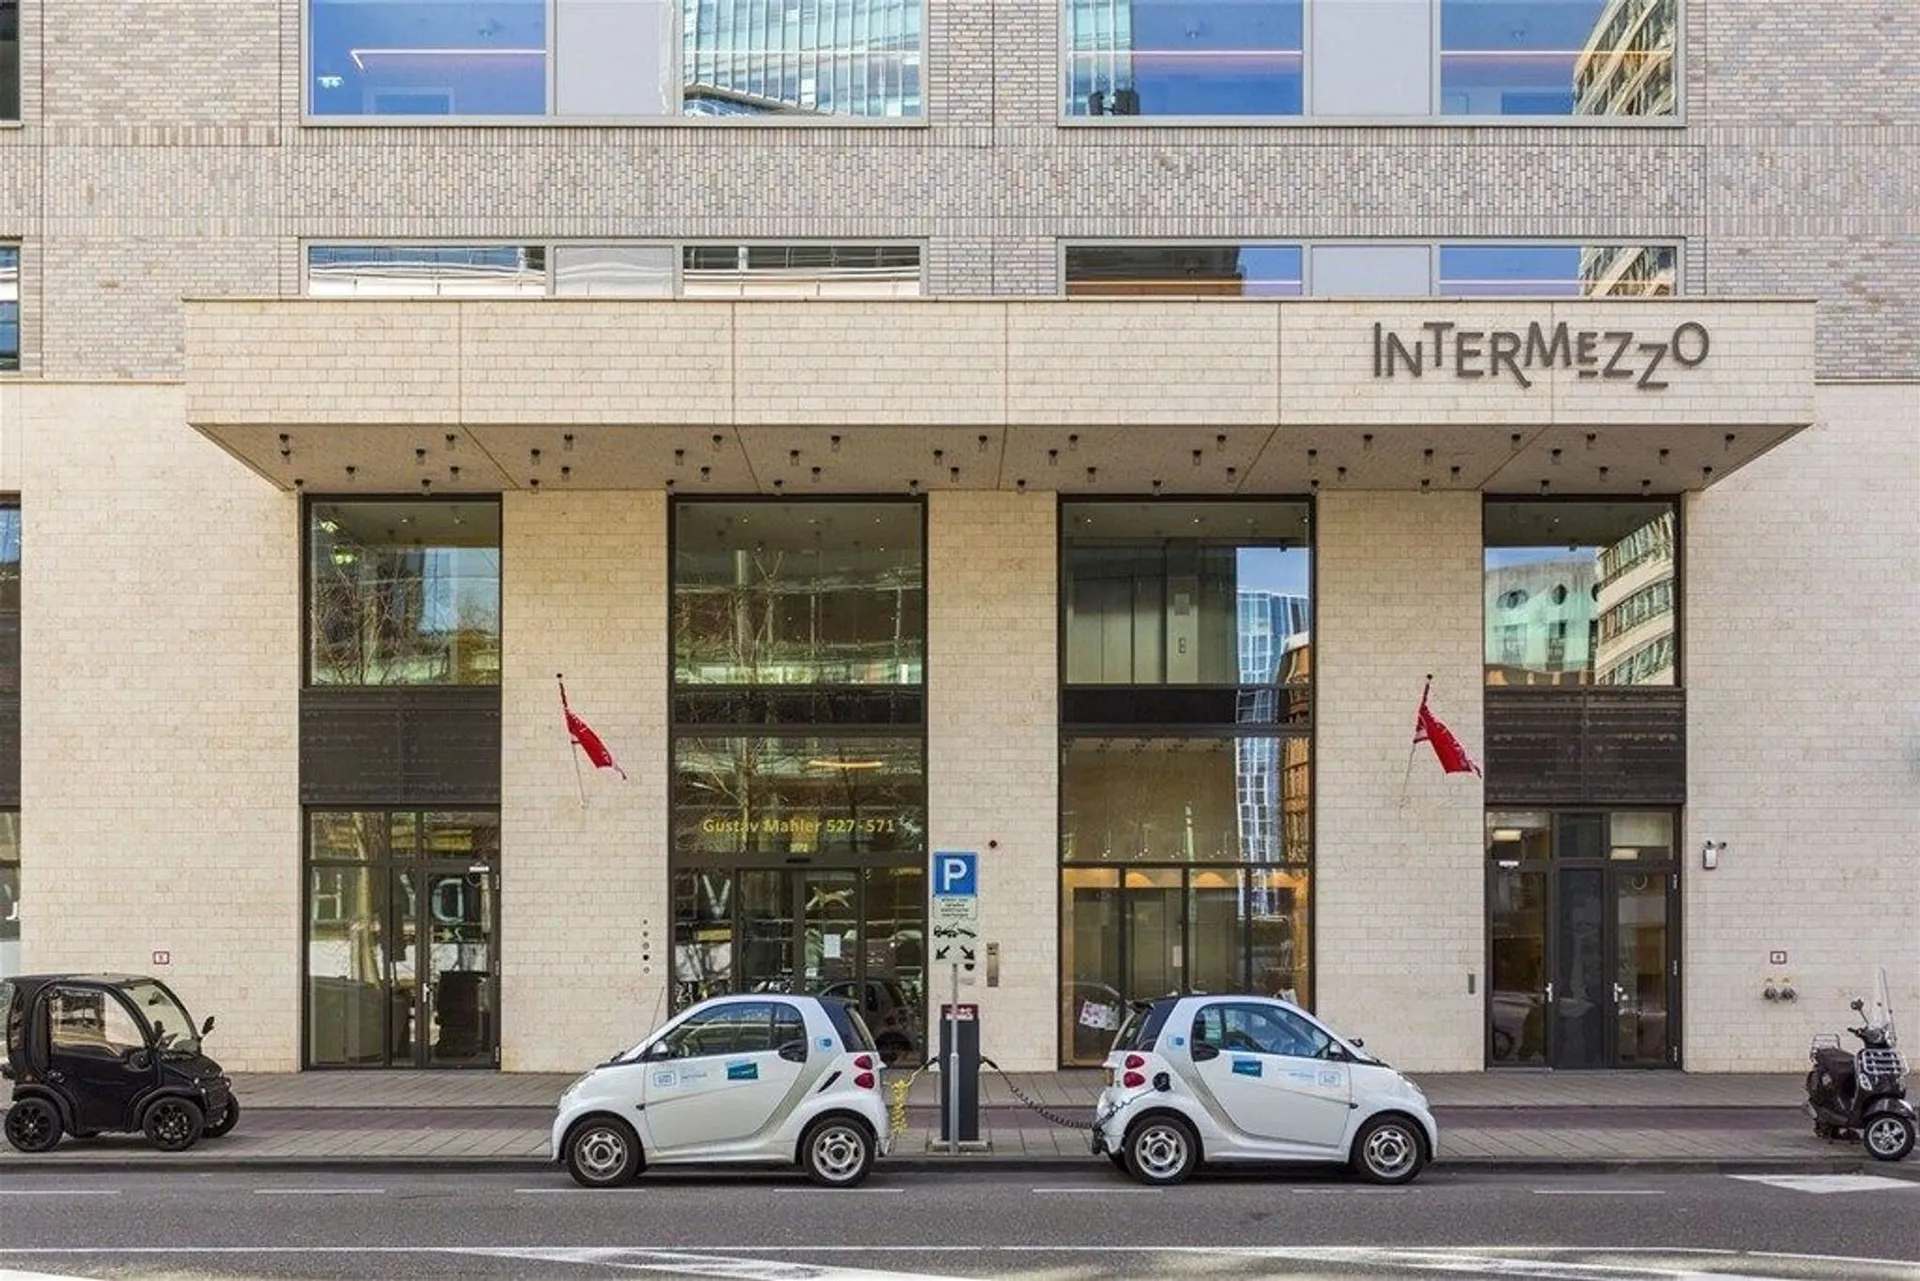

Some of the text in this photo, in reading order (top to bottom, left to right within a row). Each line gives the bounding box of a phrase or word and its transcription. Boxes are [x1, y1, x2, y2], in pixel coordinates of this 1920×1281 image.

[1373, 321, 1710, 389] INTERMEZZO
[703, 818, 758, 833] Gustav
[763, 818, 821, 833] Mahler
[943, 858, 968, 891] P
